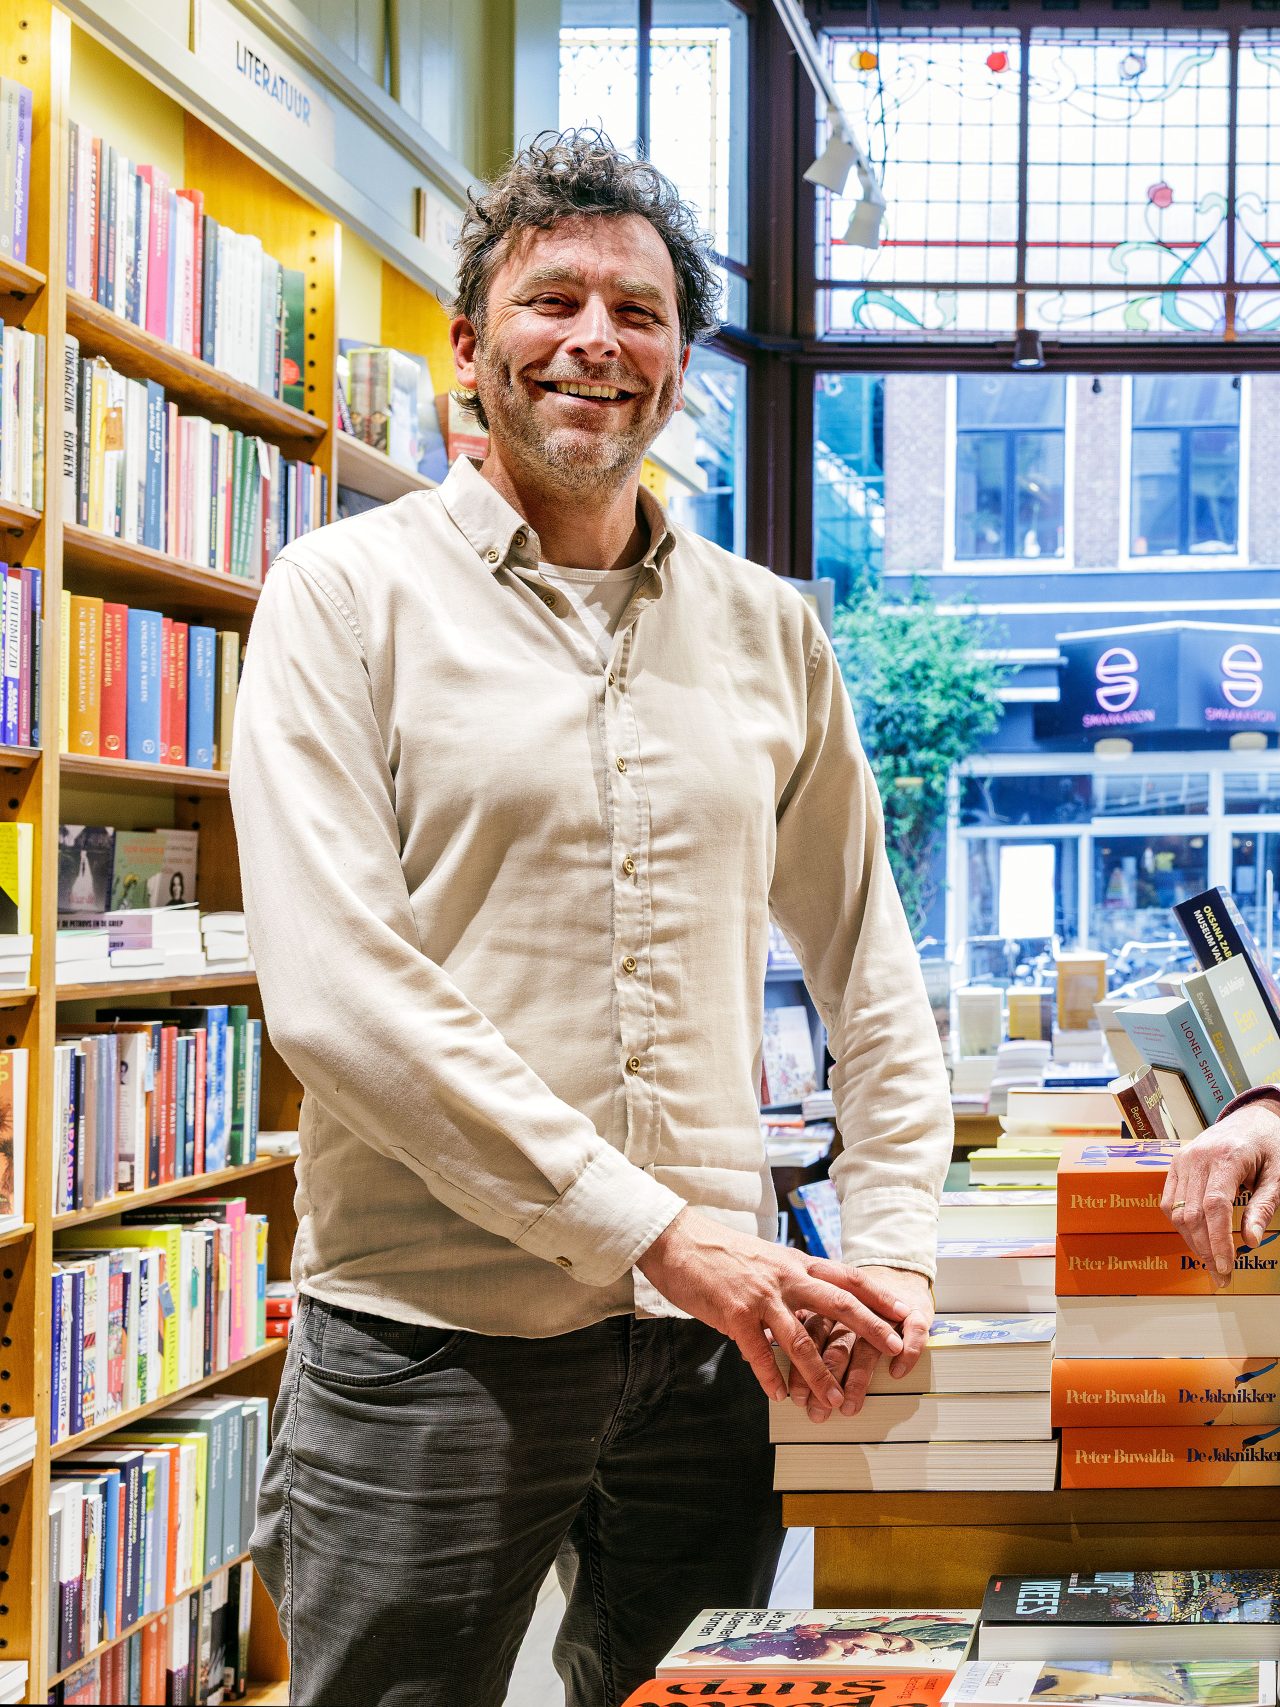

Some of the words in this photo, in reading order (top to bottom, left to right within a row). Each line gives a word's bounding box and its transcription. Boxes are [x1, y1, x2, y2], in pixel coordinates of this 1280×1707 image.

[235, 40, 312, 127] LITERATUUR
[8, 591, 20, 669] INTERMEZZO
[1193, 909, 1215, 948] MUSEUM
[1203, 905, 1222, 941] OKSANA
[1180, 1019, 1202, 1060] LIONEL
[1199, 1060, 1224, 1103] SHRIVER
[1130, 1105, 1146, 1131] Benny
[1070, 1194, 1107, 1209] Peter
[1109, 1193, 1162, 1209] Buwald
[1068, 1255, 1105, 1272] Peter
[1107, 1255, 1169, 1271] Buwalda
[1180, 1255, 1201, 1270] De
[1065, 1389, 1103, 1405] Peter
[1104, 1388, 1166, 1404] Buwalda
[1178, 1388, 1198, 1404] De
[1199, 1387, 1277, 1404] Jaknikker
[1074, 1448, 1111, 1464] Peter
[1113, 1448, 1175, 1465] Buwalda
[1186, 1448, 1206, 1463] De
[1016, 1581, 1061, 1615] VREES
[697, 1611, 732, 1638] dromen
[716, 1611, 746, 1639] bloemen
[747, 1611, 769, 1627] geen
[763, 1618, 783, 1632] zult
[774, 1611, 792, 1619] Je
[666, 1678, 886, 1696] dans
